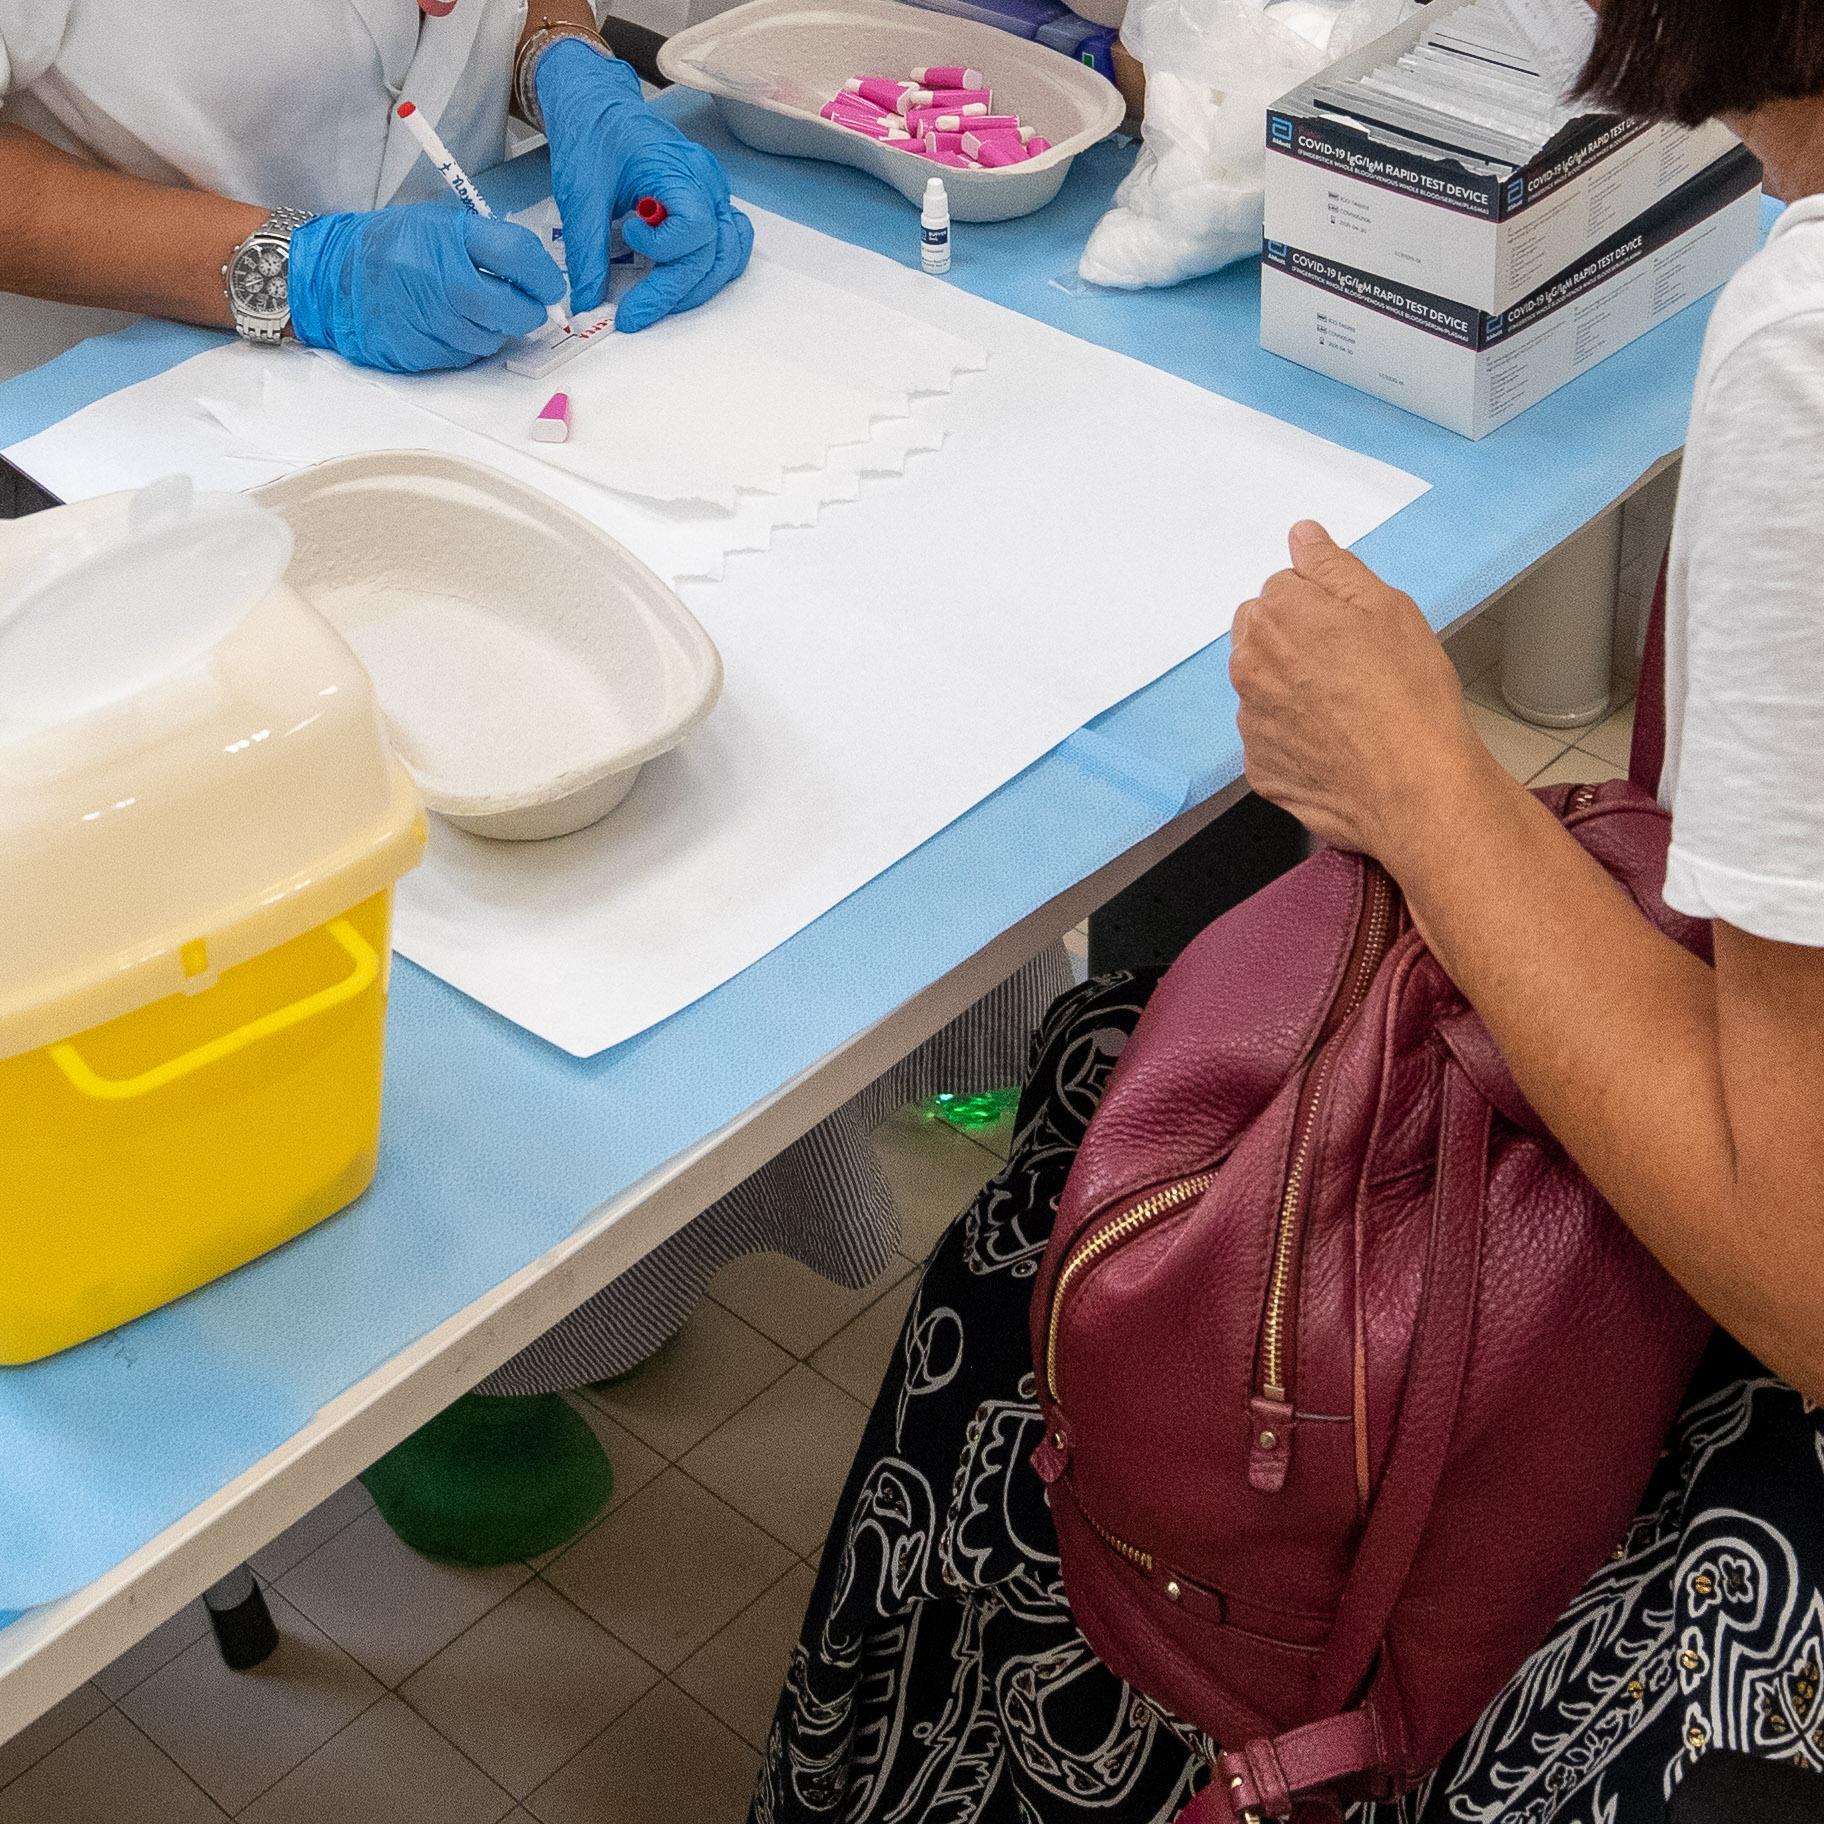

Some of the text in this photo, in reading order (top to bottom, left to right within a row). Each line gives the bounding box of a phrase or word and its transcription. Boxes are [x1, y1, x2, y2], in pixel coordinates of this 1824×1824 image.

[1298, 135, 1489, 205] COVID-19 IgG/IgM RAPID TEST DEVICE
[1527, 164, 1561, 193] COVID-19
[1587, 133, 1609, 155] RAPID
[1609, 125, 1626, 143] TEST
[1292, 252, 1468, 333] COVID-19 IgG/IgM RAPID TEST DEVICE
[1507, 294, 1544, 323] COVID-19
[1572, 265, 1597, 285] RAPID
[1597, 255, 1615, 273] TEST
[1615, 234, 1643, 260] DEVICE
